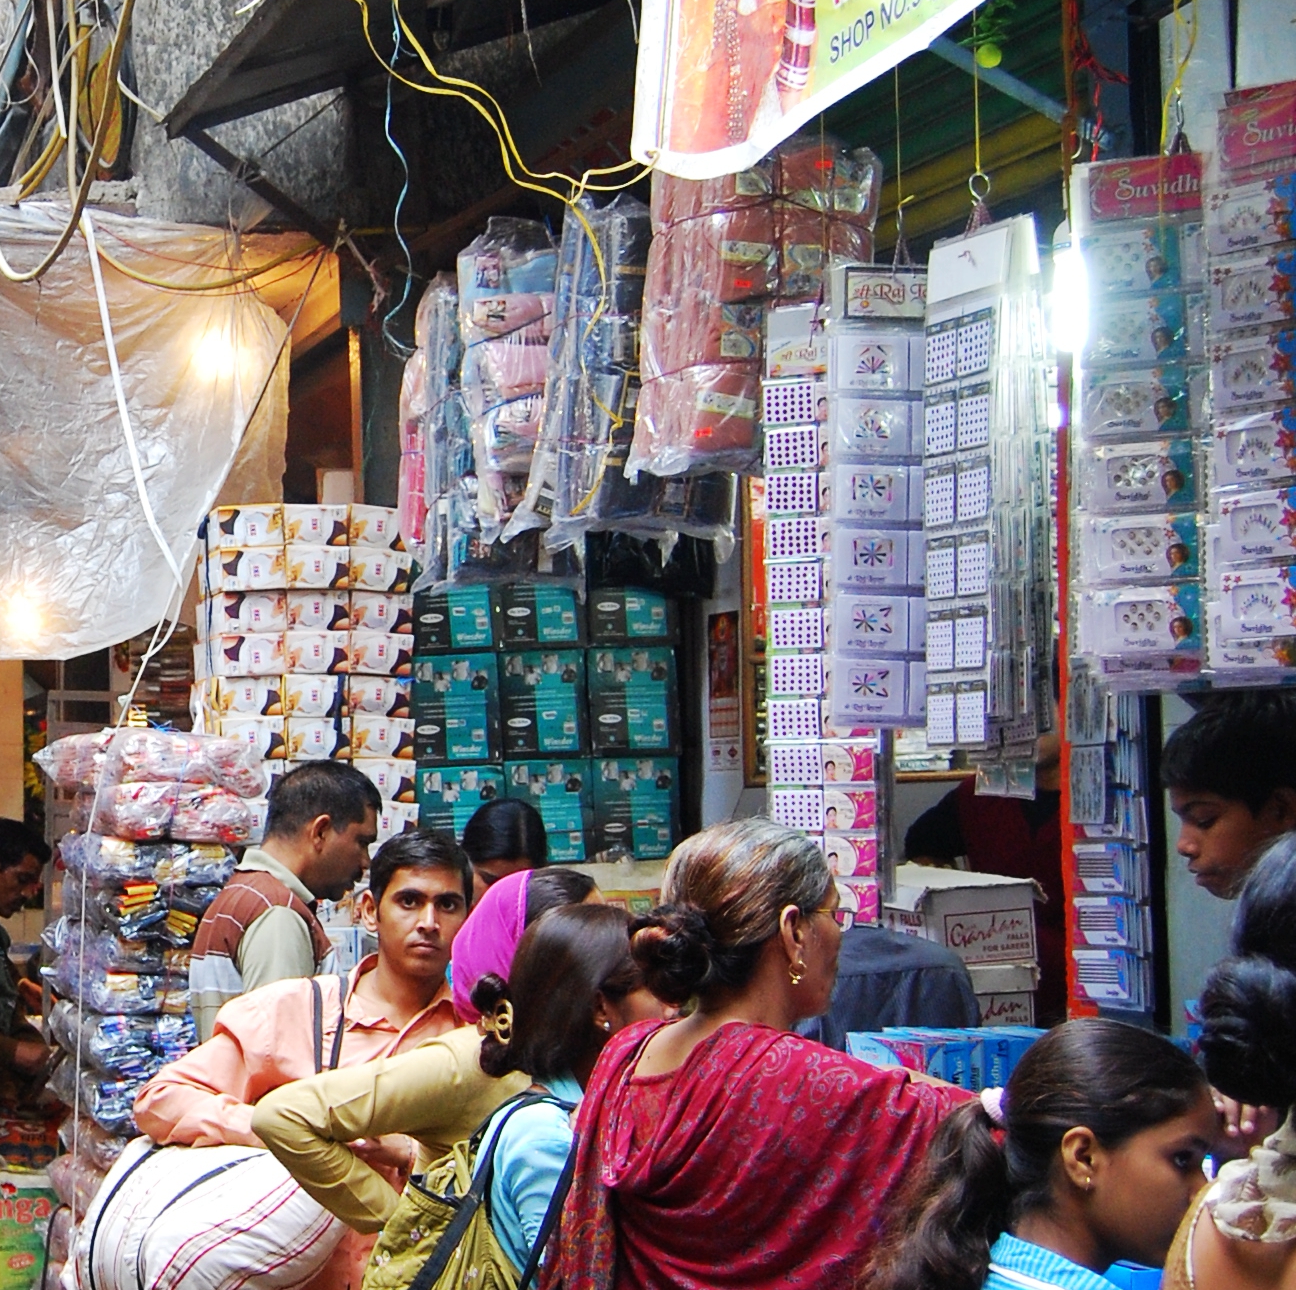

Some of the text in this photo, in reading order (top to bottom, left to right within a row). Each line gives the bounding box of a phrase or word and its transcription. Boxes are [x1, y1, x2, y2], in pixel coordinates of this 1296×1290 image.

[830, 11, 875, 63] SHOP
[1115, 173, 1200, 201] Suvidh
[873, 283, 905, 305] Raj
[950, 915, 1023, 948] Gardan
